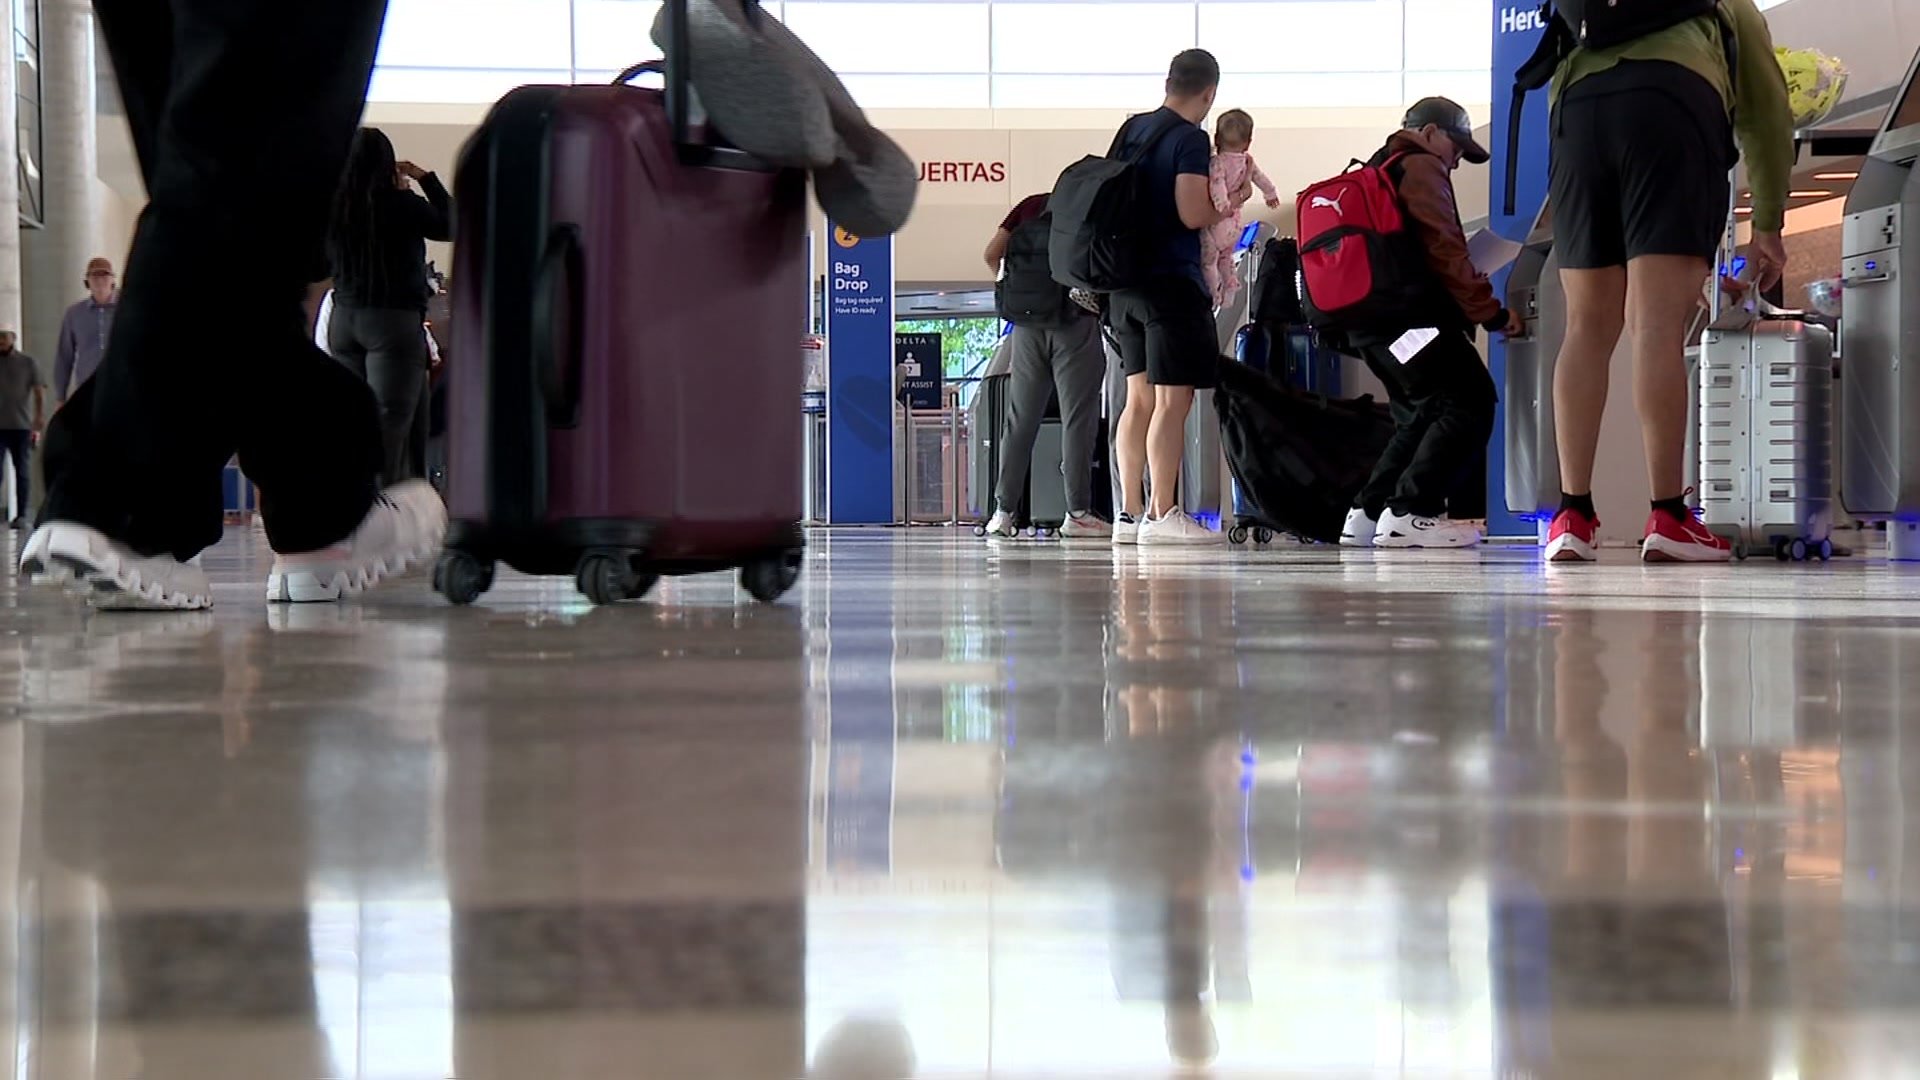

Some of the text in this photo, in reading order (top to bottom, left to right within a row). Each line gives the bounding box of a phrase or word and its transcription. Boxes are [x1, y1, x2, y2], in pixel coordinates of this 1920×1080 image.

[835, 262, 860, 278] Bag
[835, 278, 869, 293] Drop
[835, 296, 884, 305] Bag tag required
[860, 306, 877, 315] ready
[895, 337, 927, 345] DELTA
[911, 381, 934, 389] ASSIST
